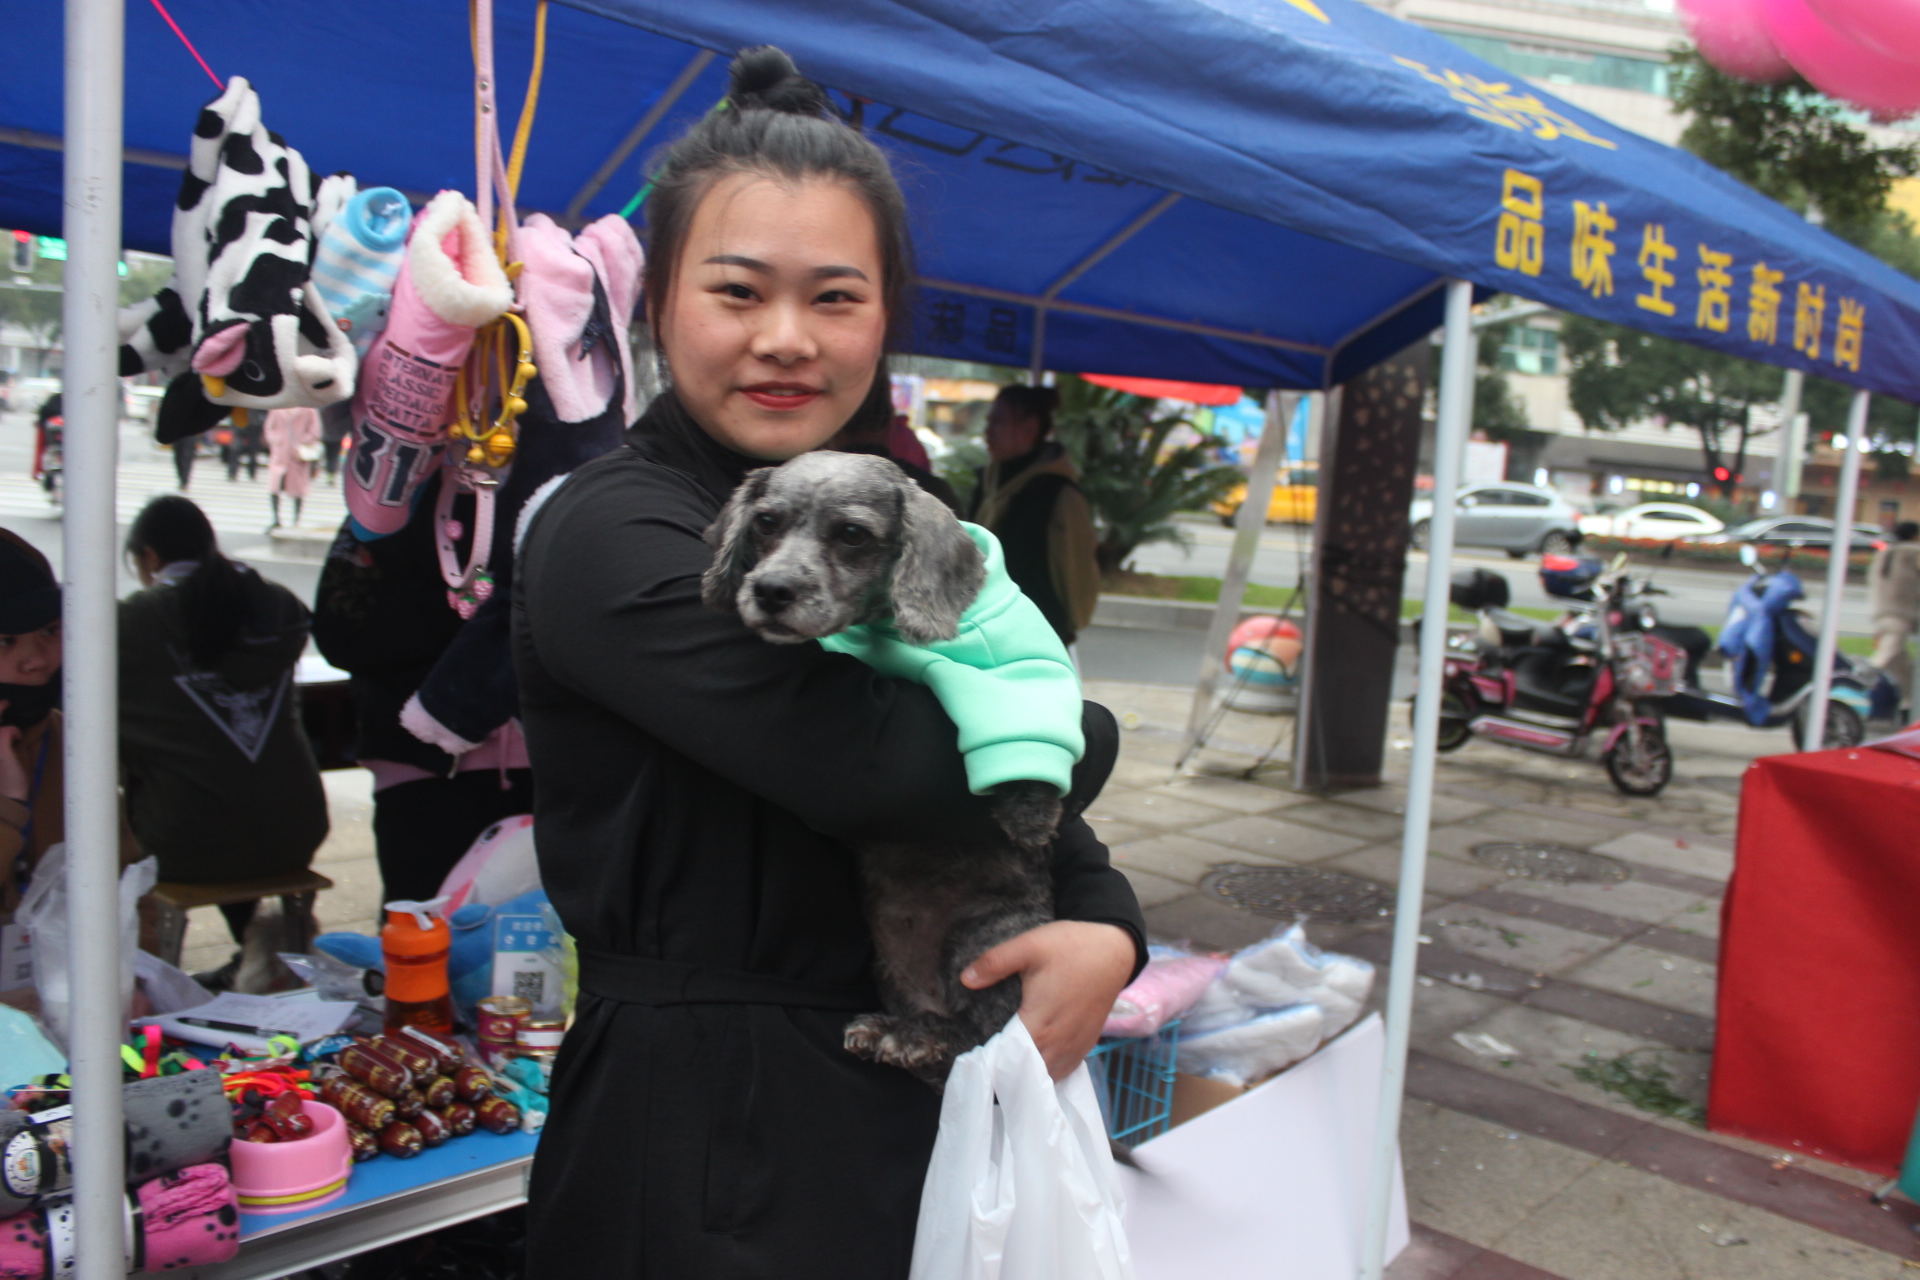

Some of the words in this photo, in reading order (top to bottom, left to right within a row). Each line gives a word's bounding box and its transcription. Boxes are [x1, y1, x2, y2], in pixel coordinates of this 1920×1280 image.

[1495, 168, 1866, 372] 品味生活新时尚
